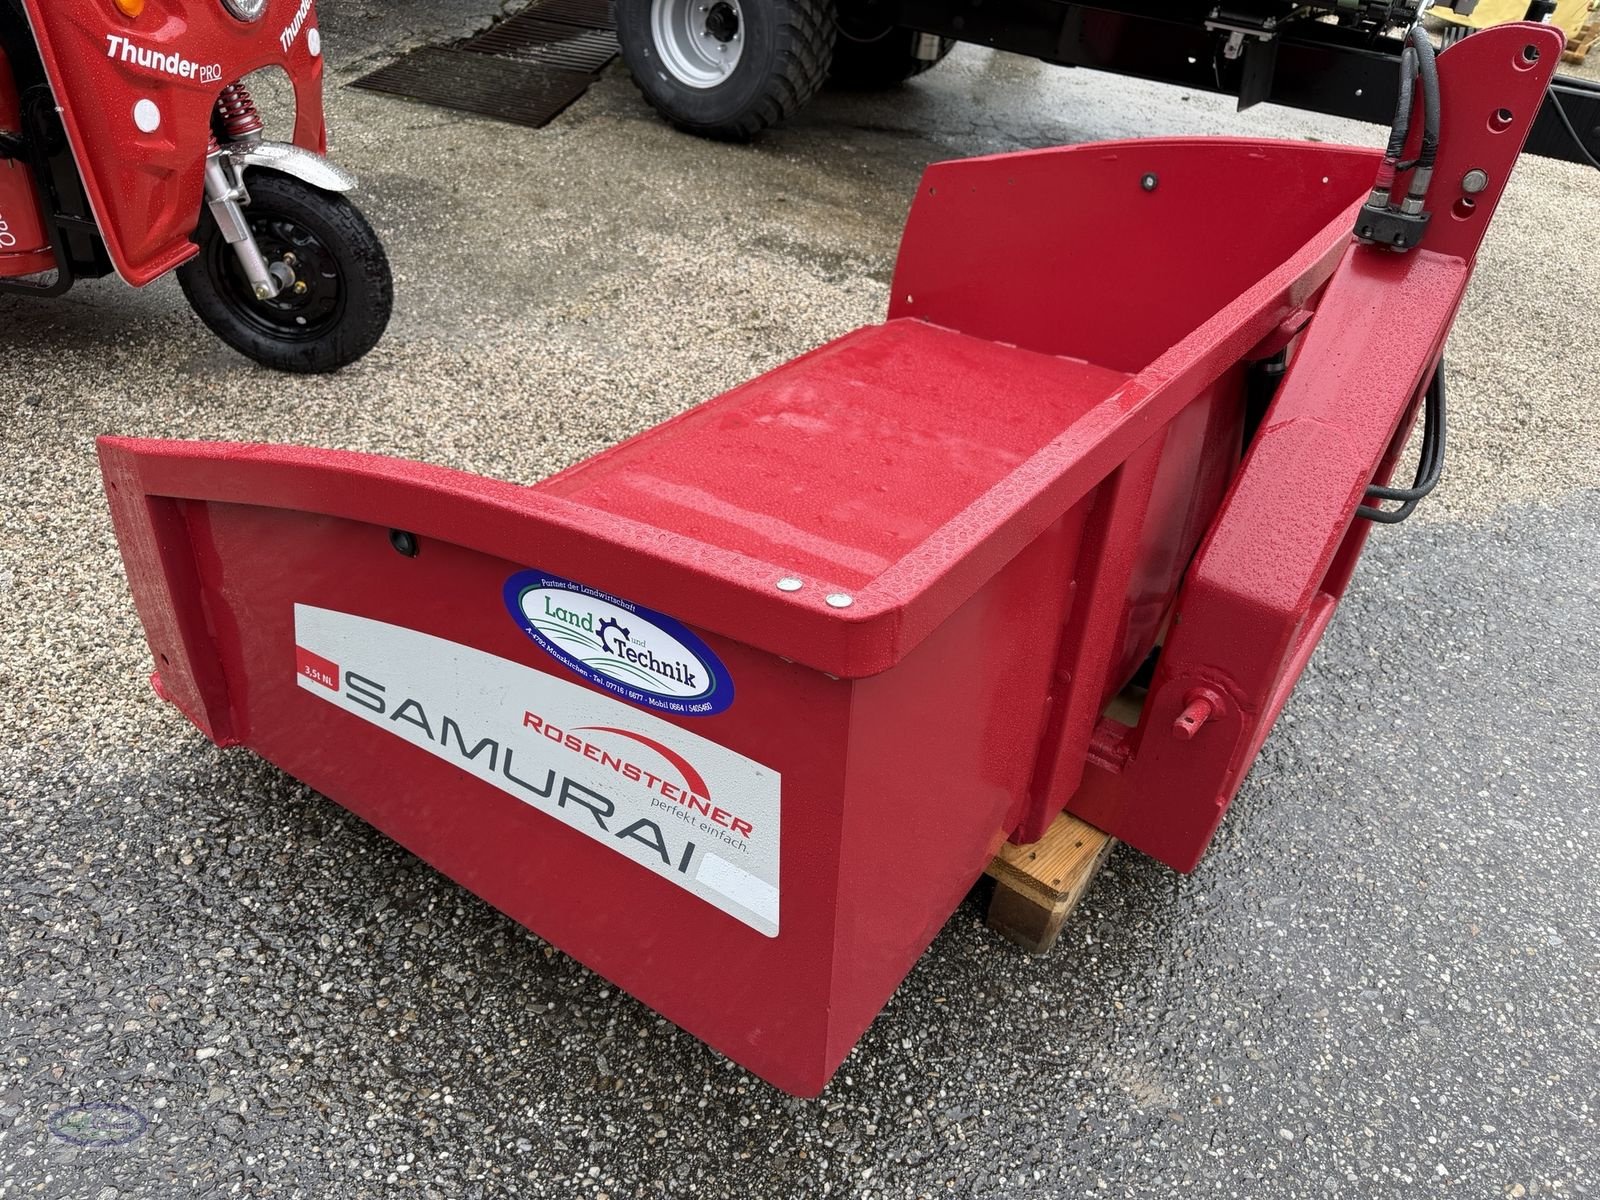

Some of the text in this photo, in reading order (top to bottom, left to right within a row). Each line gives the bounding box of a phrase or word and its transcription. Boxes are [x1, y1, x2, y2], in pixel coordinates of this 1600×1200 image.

[106, 34, 222, 83] Thunder PRO
[541, 578, 636, 612] Partner der Landwirtschaft
[544, 595, 696, 689] Land und Technik
[304, 665, 334, 687] 3,5t NL
[592, 674, 605, 686] Tel.
[605, 682, 624, 694] 07716
[628, 690, 644, 701] 6677
[648, 697, 669, 709] Mobil
[669, 701, 685, 712] 0664
[345, 671, 696, 874] SAMURAI
[523, 710, 753, 839] ROSENSTEINER
[650, 797, 751, 855] perfekt einfach.
